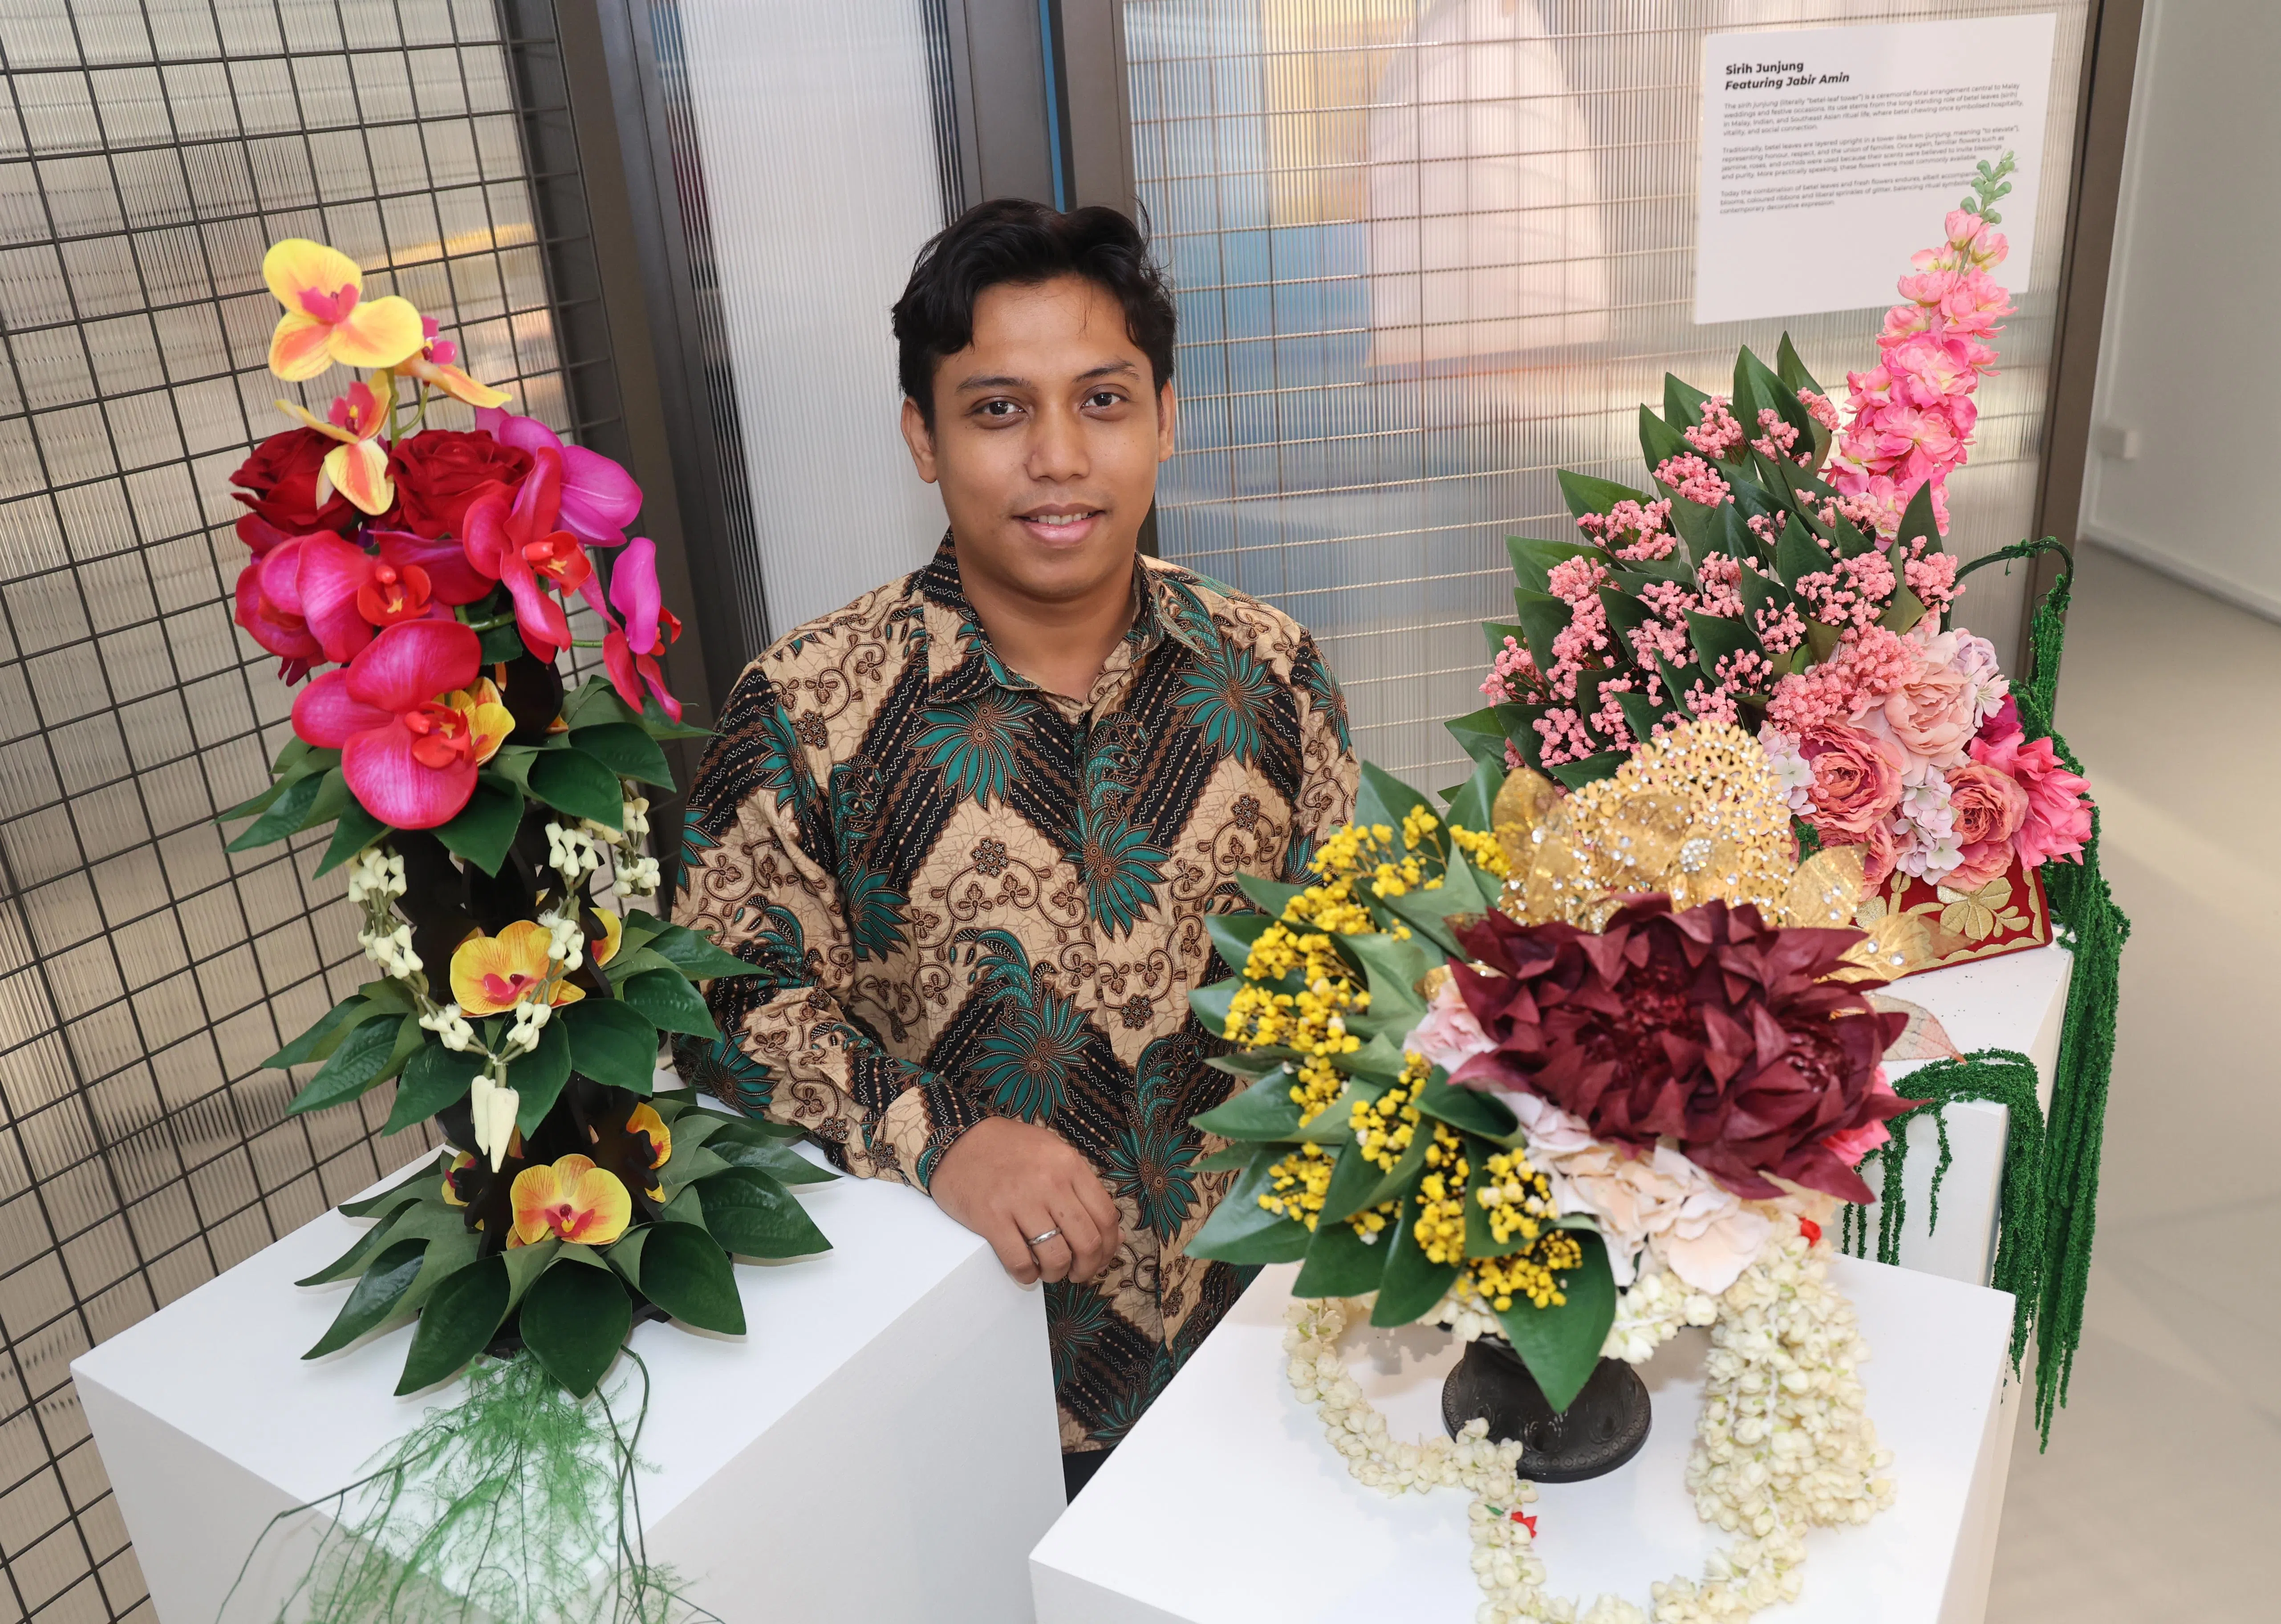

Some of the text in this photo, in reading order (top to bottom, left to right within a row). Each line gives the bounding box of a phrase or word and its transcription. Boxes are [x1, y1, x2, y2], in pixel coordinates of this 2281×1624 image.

[1726, 61, 1804, 75] Sirih Junjung
[1725, 72, 1849, 90] Featuring Jabir Amin
